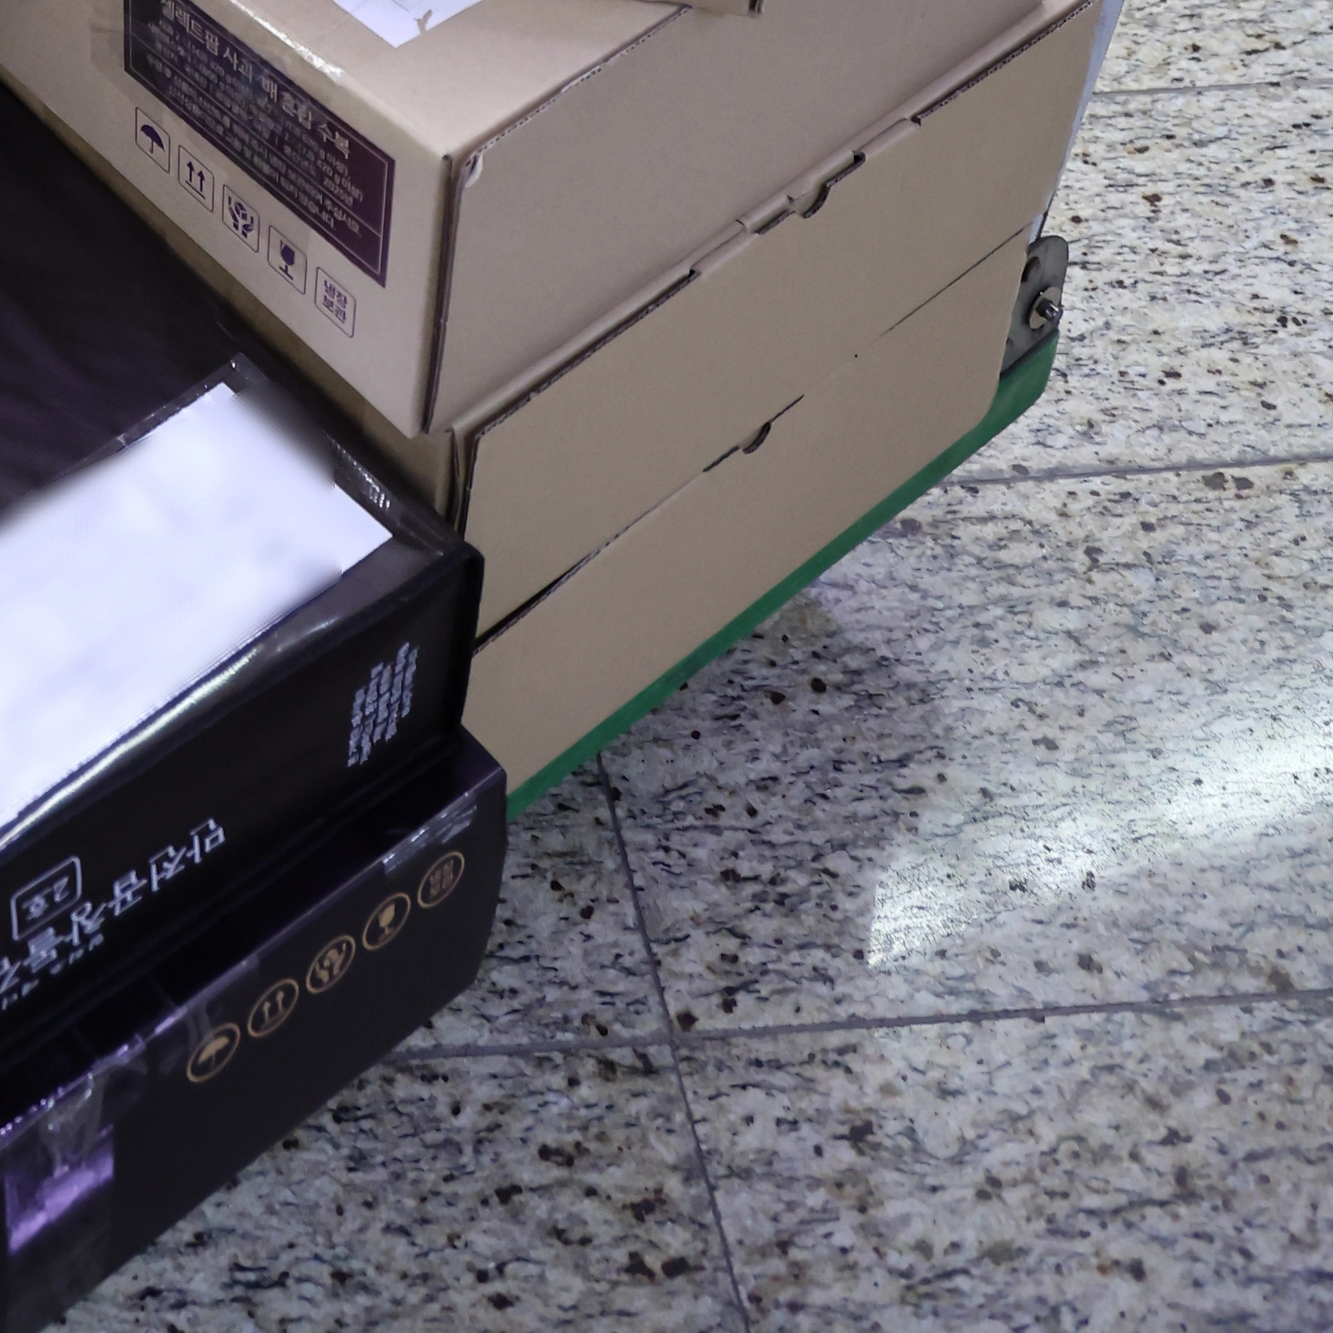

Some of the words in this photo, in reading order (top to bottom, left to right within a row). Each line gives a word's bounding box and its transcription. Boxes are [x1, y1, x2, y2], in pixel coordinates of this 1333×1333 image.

[324, 279, 347, 308] 냉장
[322, 295, 346, 324] 보관
[22, 876, 70, 921] 2호
